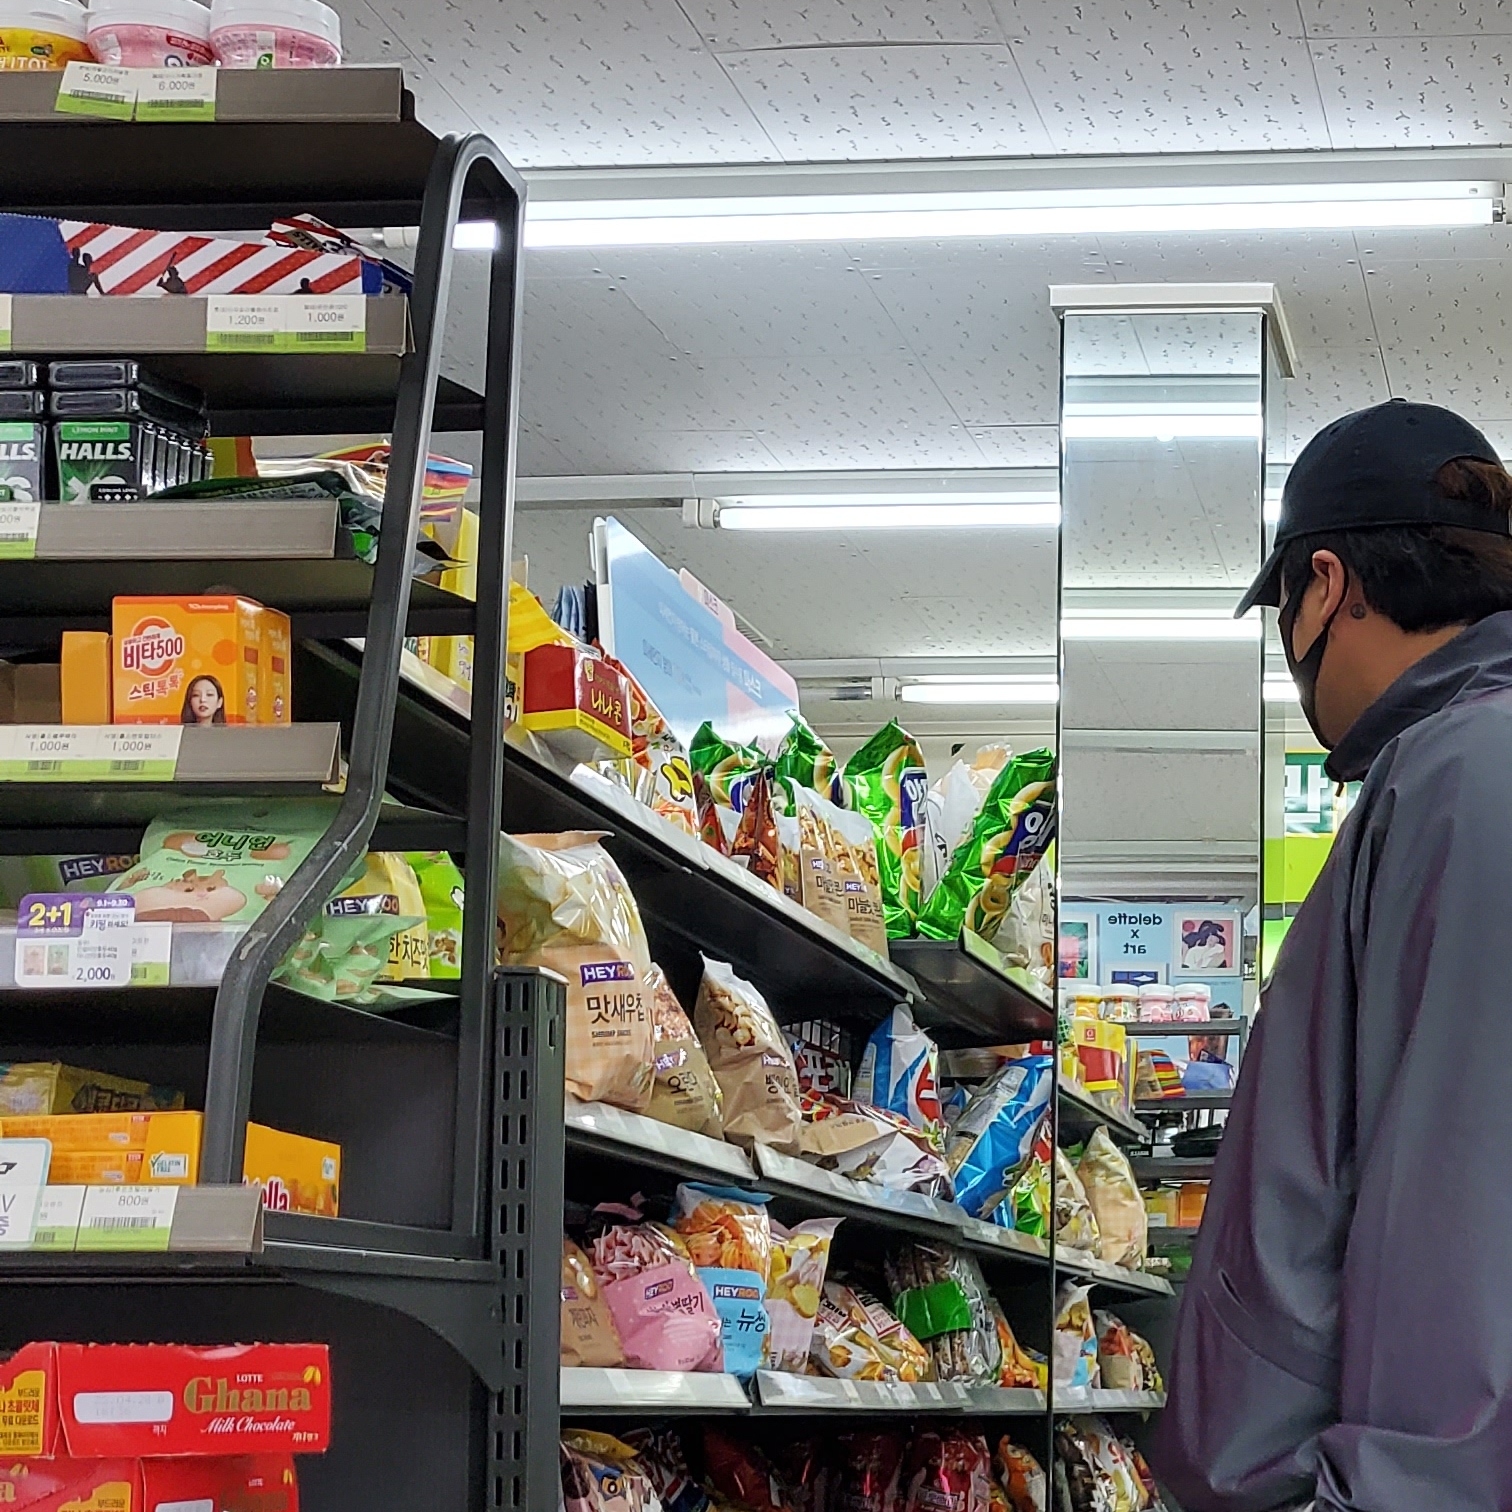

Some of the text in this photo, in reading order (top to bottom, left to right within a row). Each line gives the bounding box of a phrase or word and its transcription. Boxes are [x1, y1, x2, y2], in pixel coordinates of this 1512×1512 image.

[0, 442, 36, 461] LLS
[60, 442, 132, 461] HALLS
[123, 637, 184, 670] 비타500
[29, 902, 72, 926] 2+1
[236, 1374, 264, 1383] LOTTE
[184, 1377, 312, 1415] Ghana
[200, 1415, 296, 1434] Milk Chocolate
